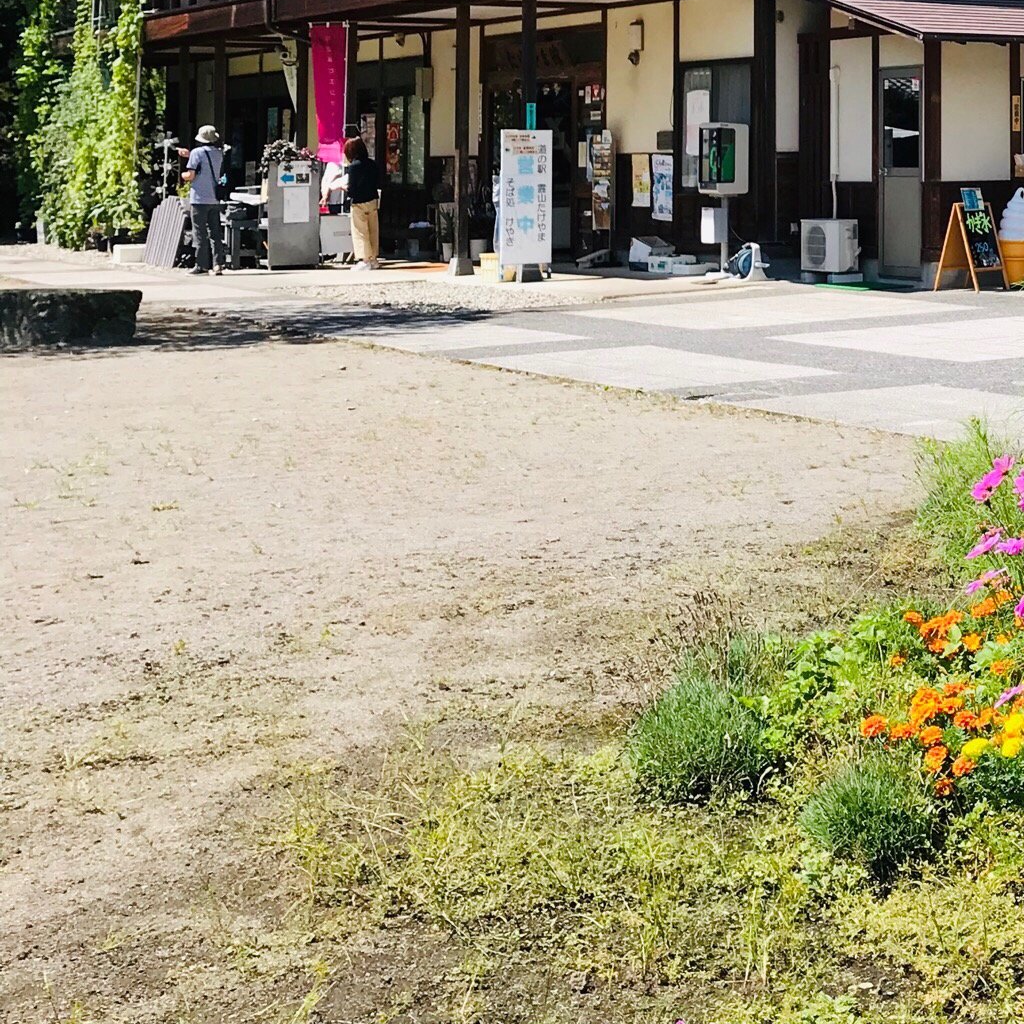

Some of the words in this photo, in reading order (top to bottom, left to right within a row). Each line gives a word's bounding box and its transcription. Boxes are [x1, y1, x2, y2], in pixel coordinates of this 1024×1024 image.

[537, 144, 547, 174] 道の駅
[517, 155, 535, 234] 営業中
